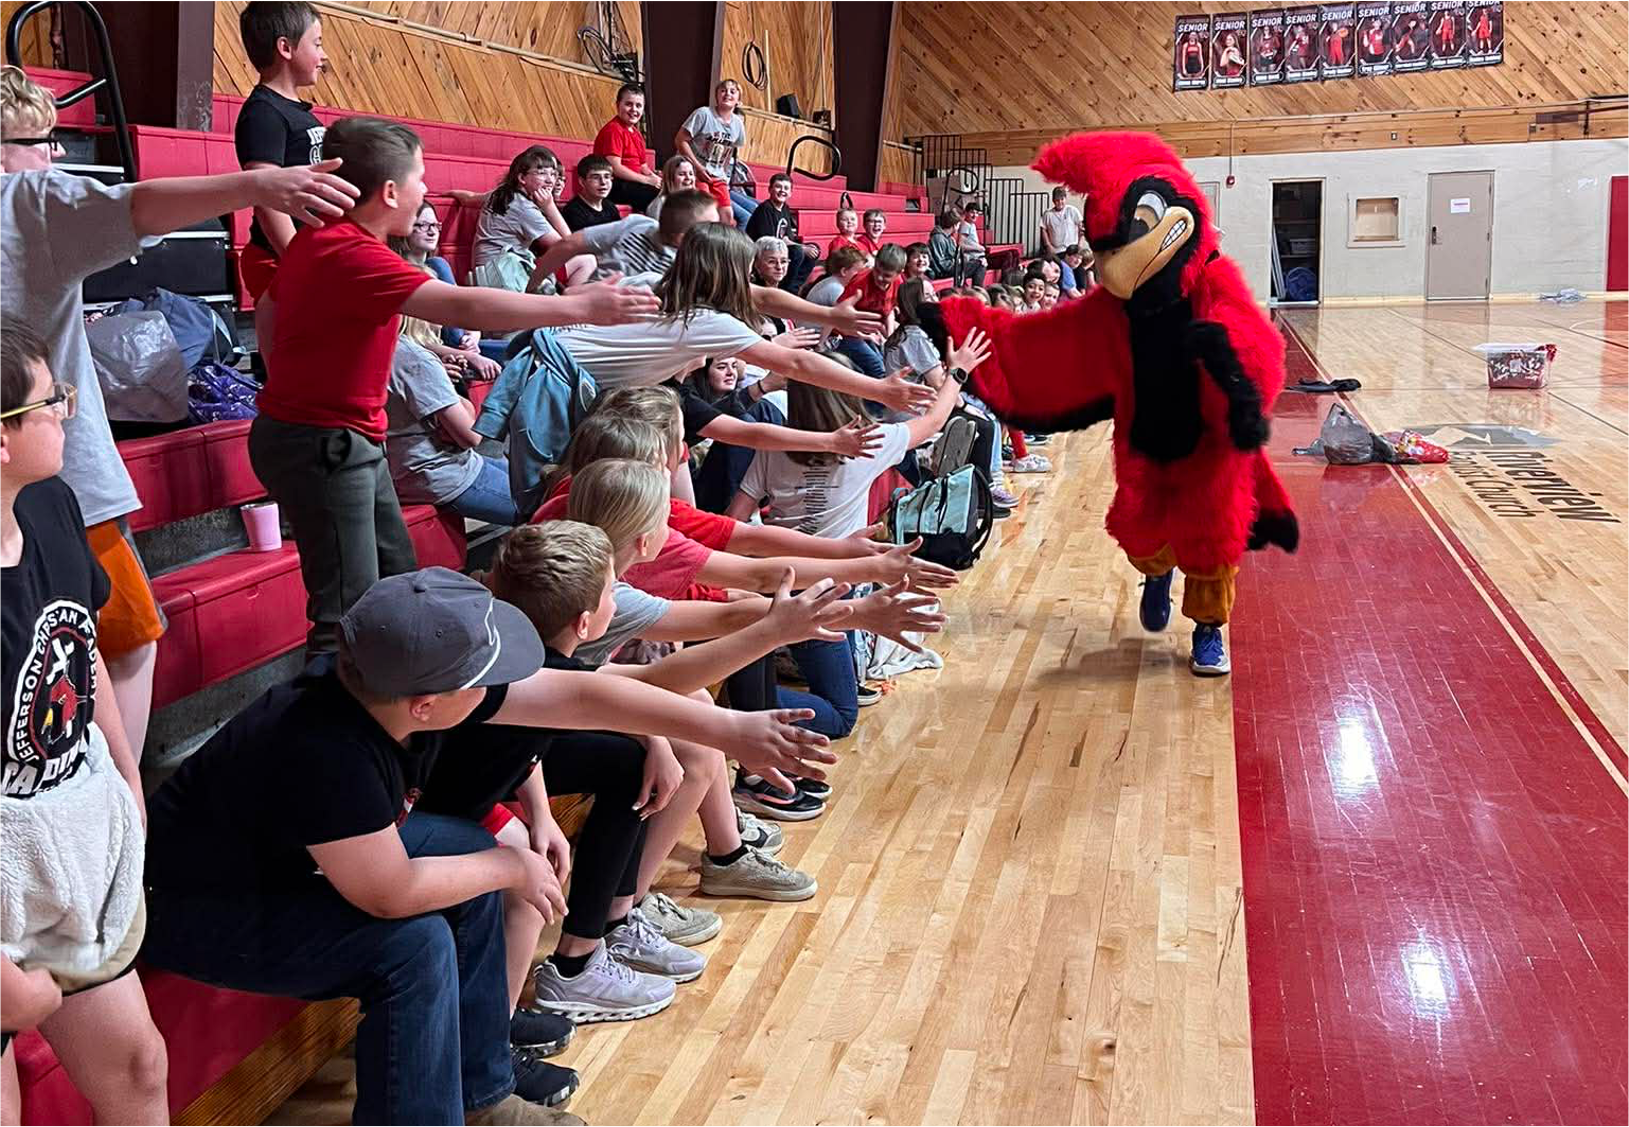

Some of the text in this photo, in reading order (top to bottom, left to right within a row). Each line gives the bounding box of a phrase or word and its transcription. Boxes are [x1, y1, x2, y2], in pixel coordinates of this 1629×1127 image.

[1394, 3, 1426, 14] SENIOR
[1431, 1, 1463, 11] SENIOR
[1321, 10, 1353, 21] SENIOR
[1358, 7, 1390, 18] SENIOR
[1252, 17, 1283, 28] SENIOR
[1286, 14, 1317, 25] SENIOR
[1178, 23, 1208, 33] SENIOR
[1214, 20, 1246, 31] SENIOR
[1480, 451, 1622, 523] Riverview
[1466, 480, 1544, 517] Church
[16, 659, 43, 763] JEFFERSON
